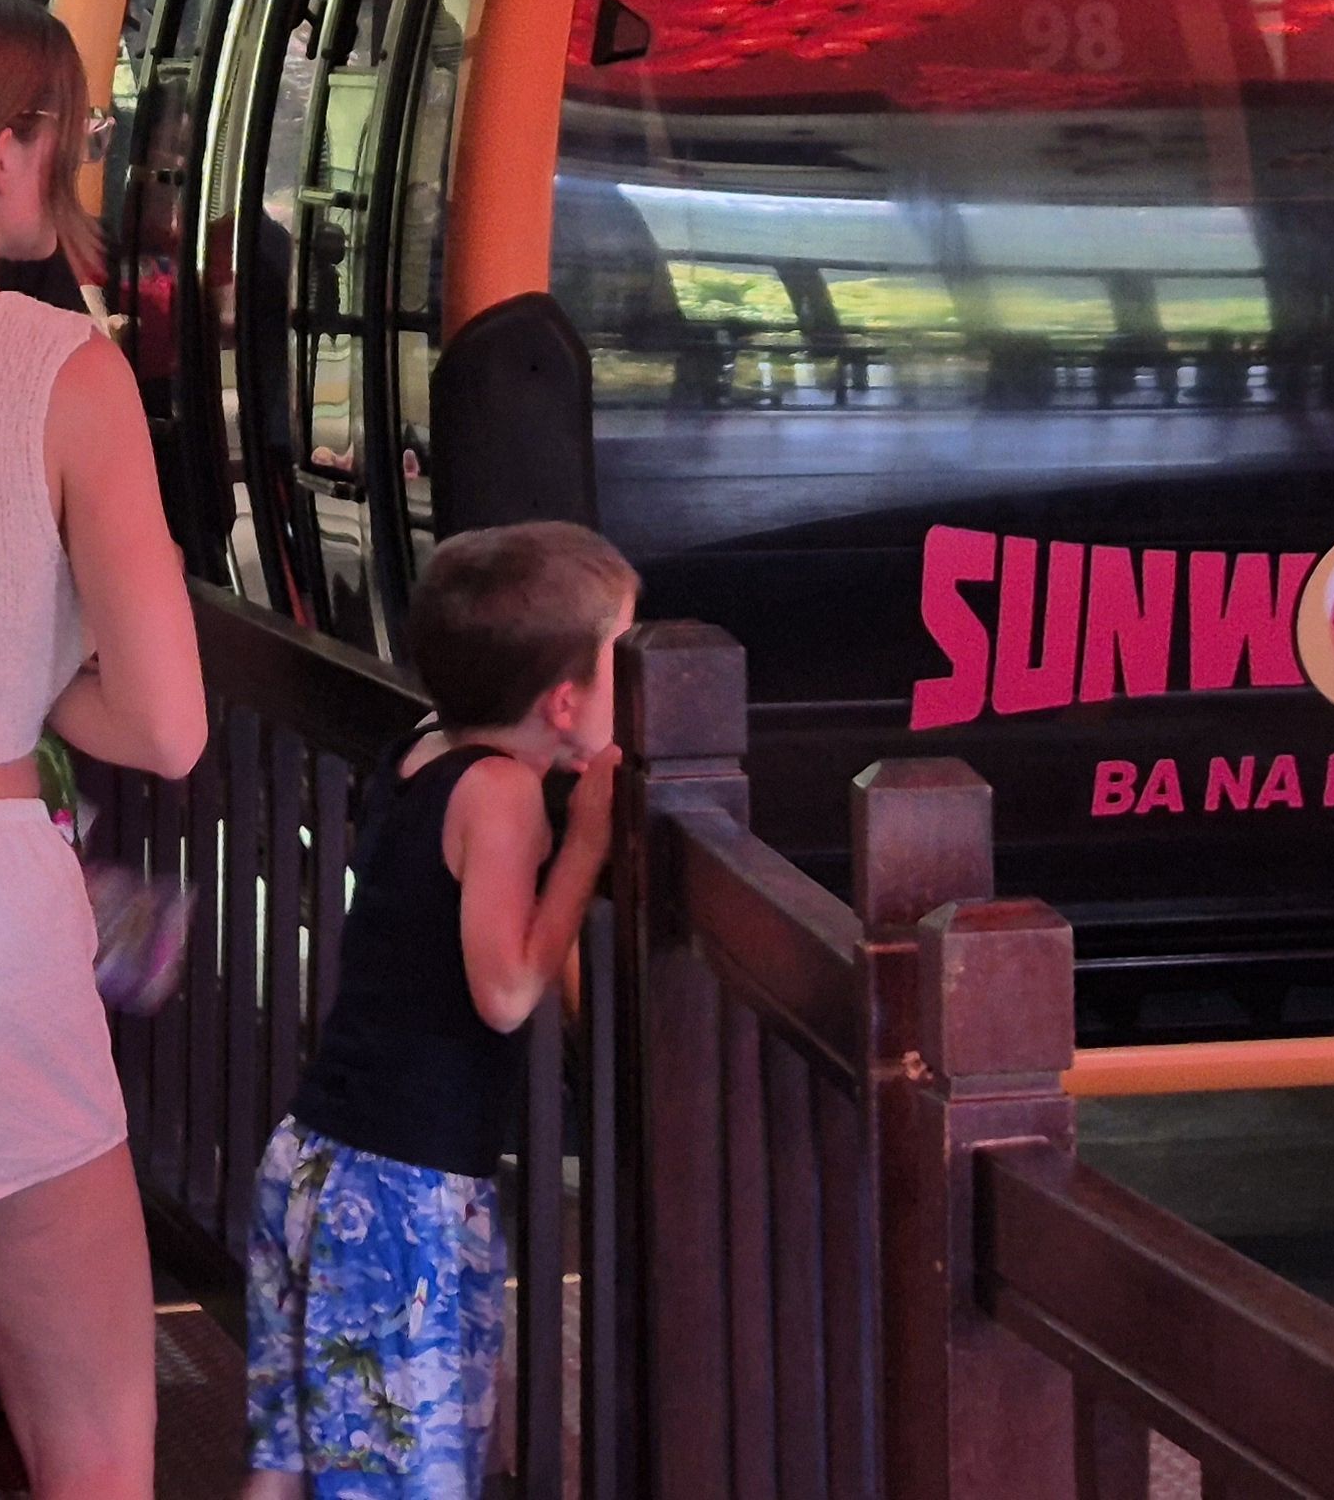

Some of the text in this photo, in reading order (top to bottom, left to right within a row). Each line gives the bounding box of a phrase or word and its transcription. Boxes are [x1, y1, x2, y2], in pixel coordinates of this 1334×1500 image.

[1022, 1, 1123, 71] 98
[1091, 758, 1184, 817] BA
[1204, 753, 1303, 811] NA
